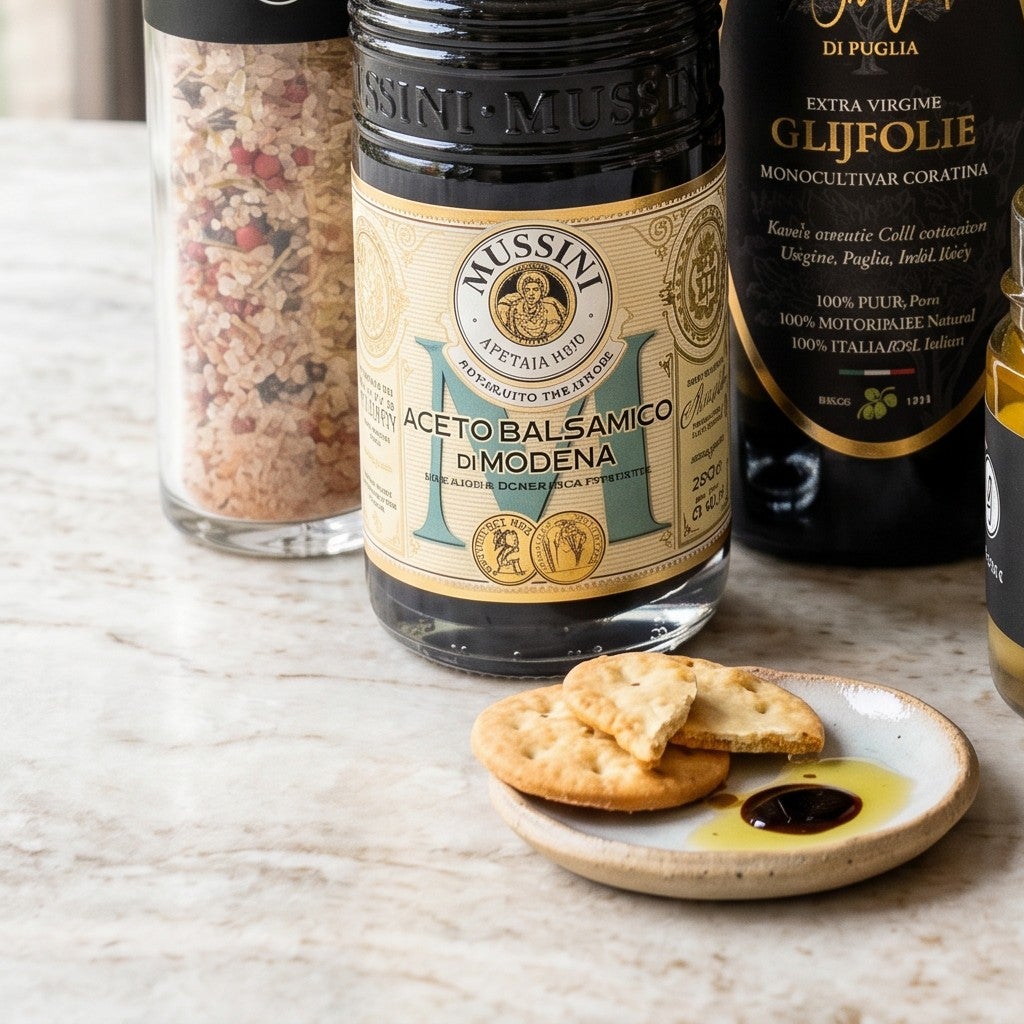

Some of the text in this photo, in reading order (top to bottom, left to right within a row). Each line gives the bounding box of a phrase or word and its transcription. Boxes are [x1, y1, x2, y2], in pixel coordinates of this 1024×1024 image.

[822, 40, 919, 57] DI PUGLIA
[806, 97, 863, 113] EXTRA
[760, 162, 989, 186] MONOCULTIVAR CORATINA
[462, 233, 604, 295] MUSSINI
[816, 294, 855, 309] 100%
[779, 311, 816, 328] 100%
[927, 308, 976, 328] Natural
[791, 336, 828, 352] 100%
[403, 406, 494, 443] ACETO
[500, 399, 673, 443] BALSAMICO
[457, 444, 617, 474] DI MODENA
